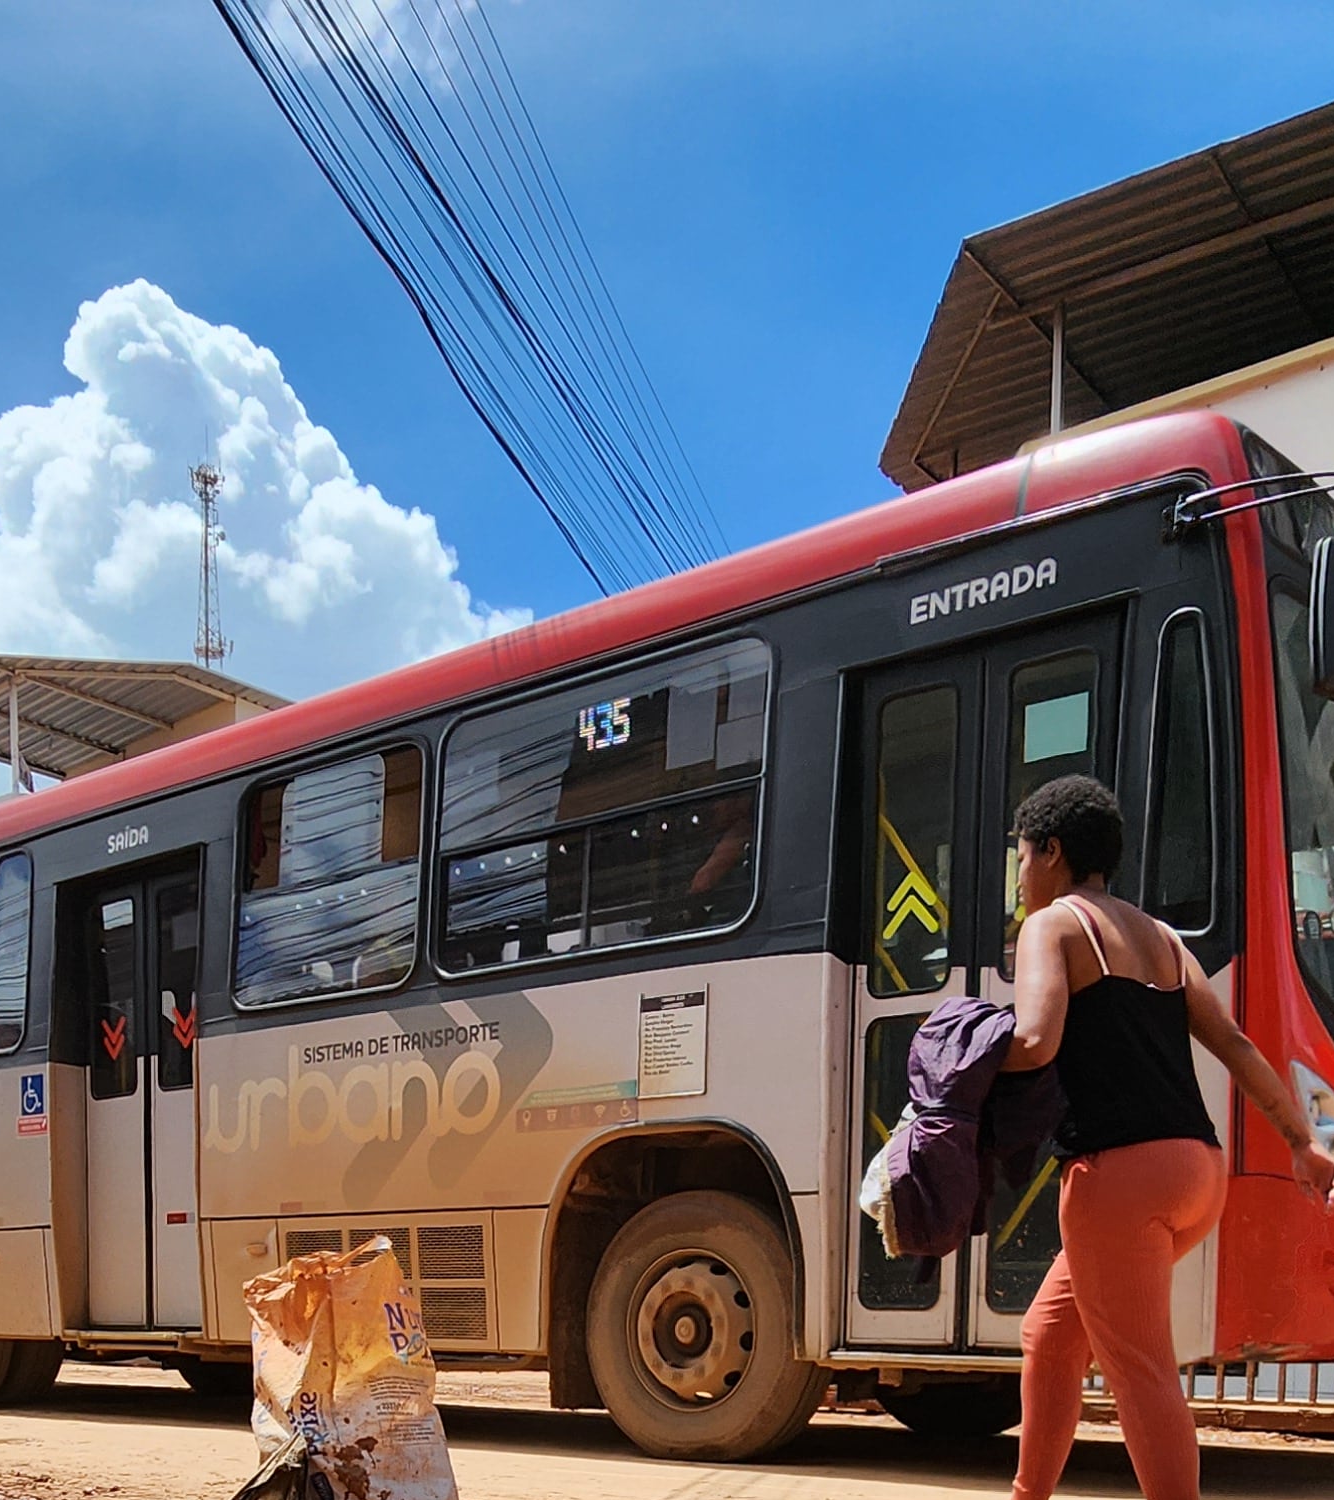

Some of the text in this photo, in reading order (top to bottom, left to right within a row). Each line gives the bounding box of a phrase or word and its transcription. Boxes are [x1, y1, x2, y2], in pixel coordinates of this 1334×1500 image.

[910, 557, 1058, 625] ENTRADA
[579, 698, 631, 752] 435
[107, 824, 149, 854] SAÍDA
[303, 1021, 500, 1064] SISTEMA DE TRANSPORTE
[203, 1044, 501, 1153] urbano
